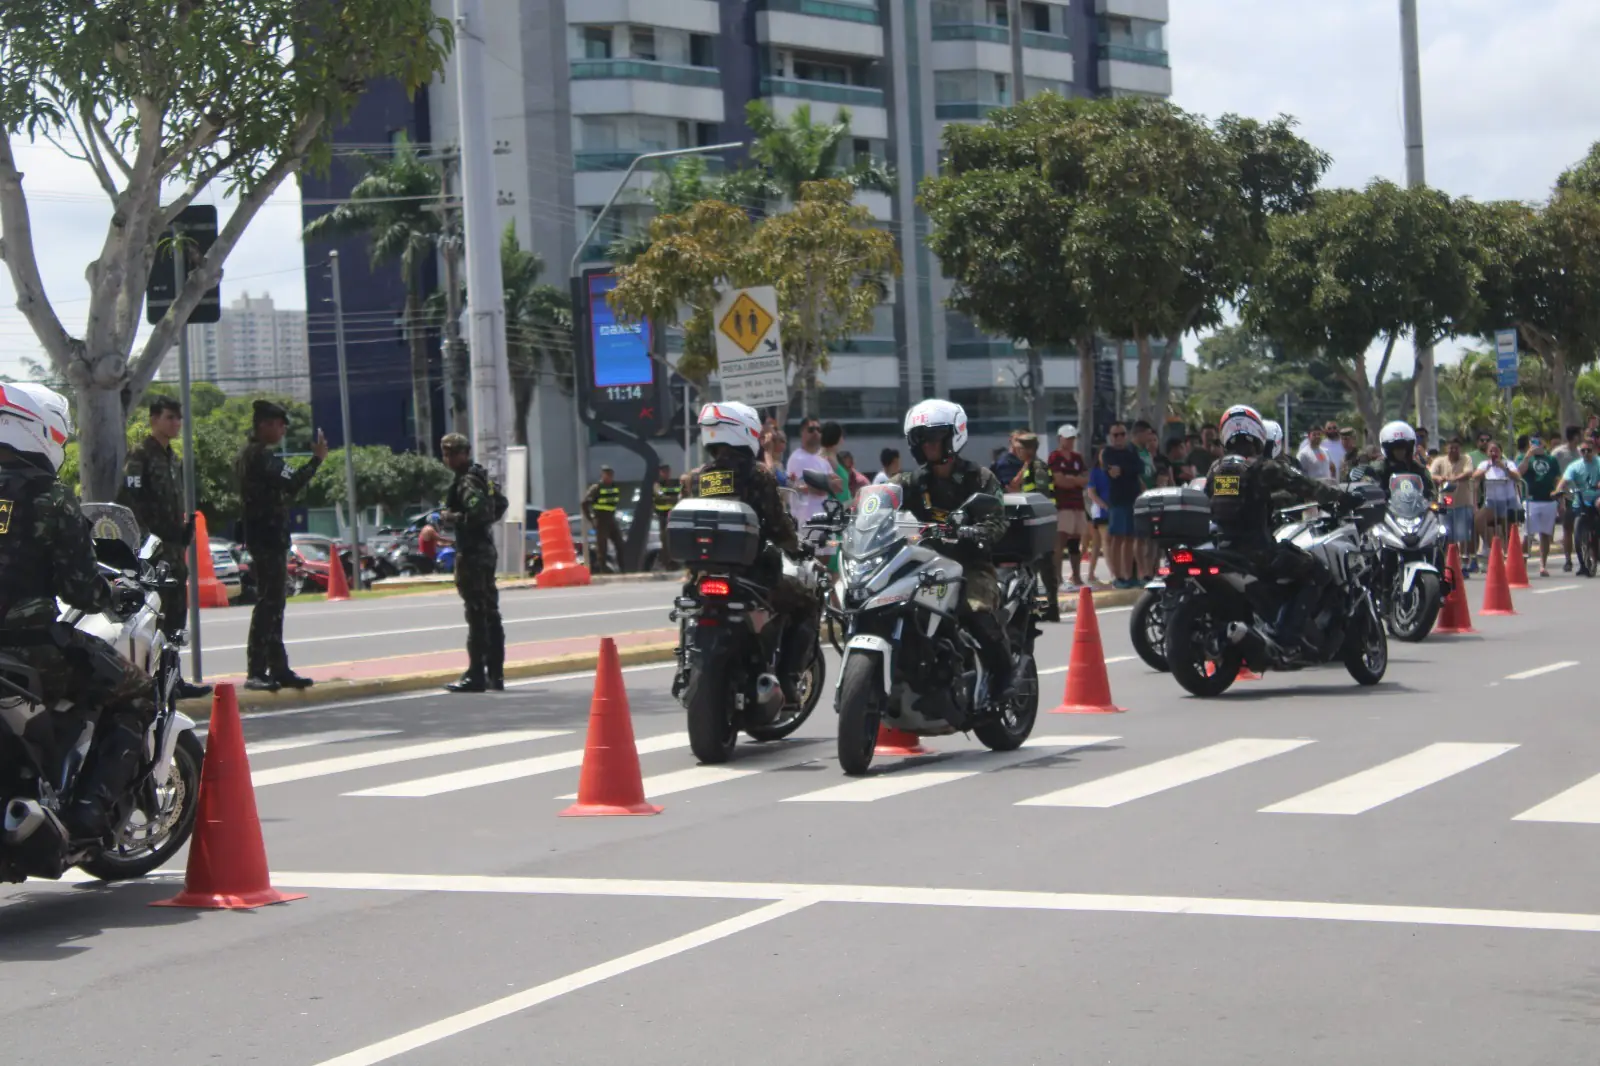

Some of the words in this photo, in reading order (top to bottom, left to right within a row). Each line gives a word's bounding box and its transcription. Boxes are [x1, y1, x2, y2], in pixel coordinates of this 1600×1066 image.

[606, 385, 642, 400] 11:14
[912, 413, 929, 425] PE
[280, 463, 294, 480] PE
[127, 475, 142, 488] PE
[921, 586, 935, 597] PE
[855, 635, 877, 645] PE
